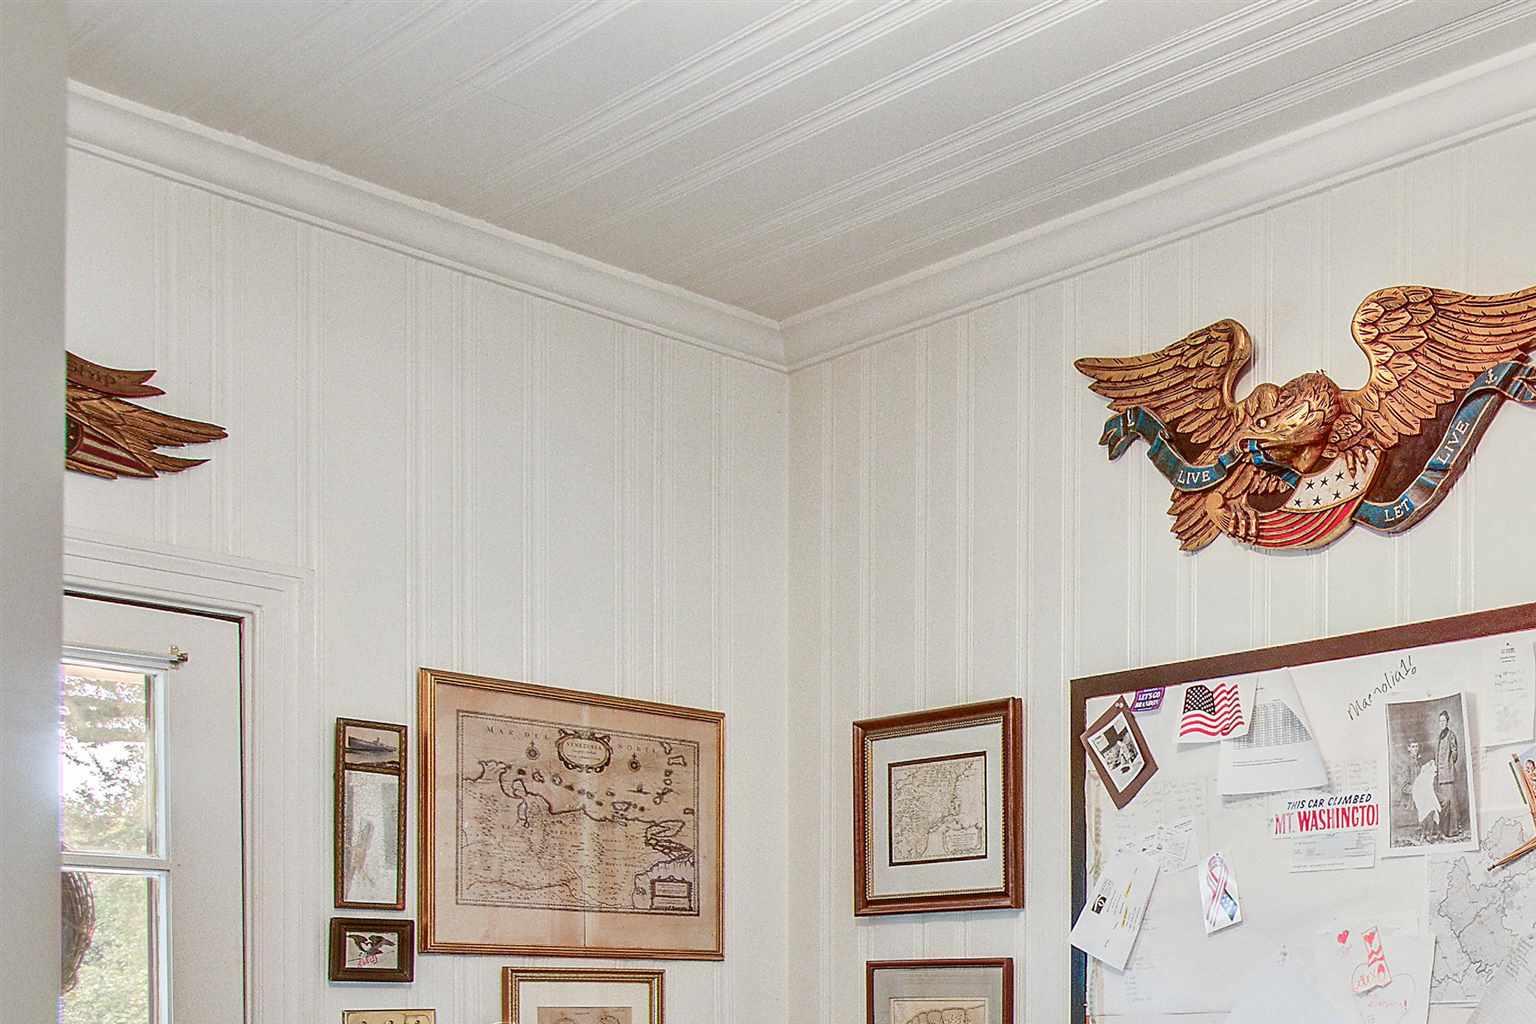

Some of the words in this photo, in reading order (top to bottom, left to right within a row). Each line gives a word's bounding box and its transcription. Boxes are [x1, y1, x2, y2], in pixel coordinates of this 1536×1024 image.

[1177, 470, 1211, 485] LIVE
[1383, 499, 1411, 522] LET
[1437, 420, 1470, 465] LIVE
[1287, 800, 1306, 810] THIS
[1307, 798, 1325, 809] CAR
[1327, 793, 1372, 807] CLIMBED
